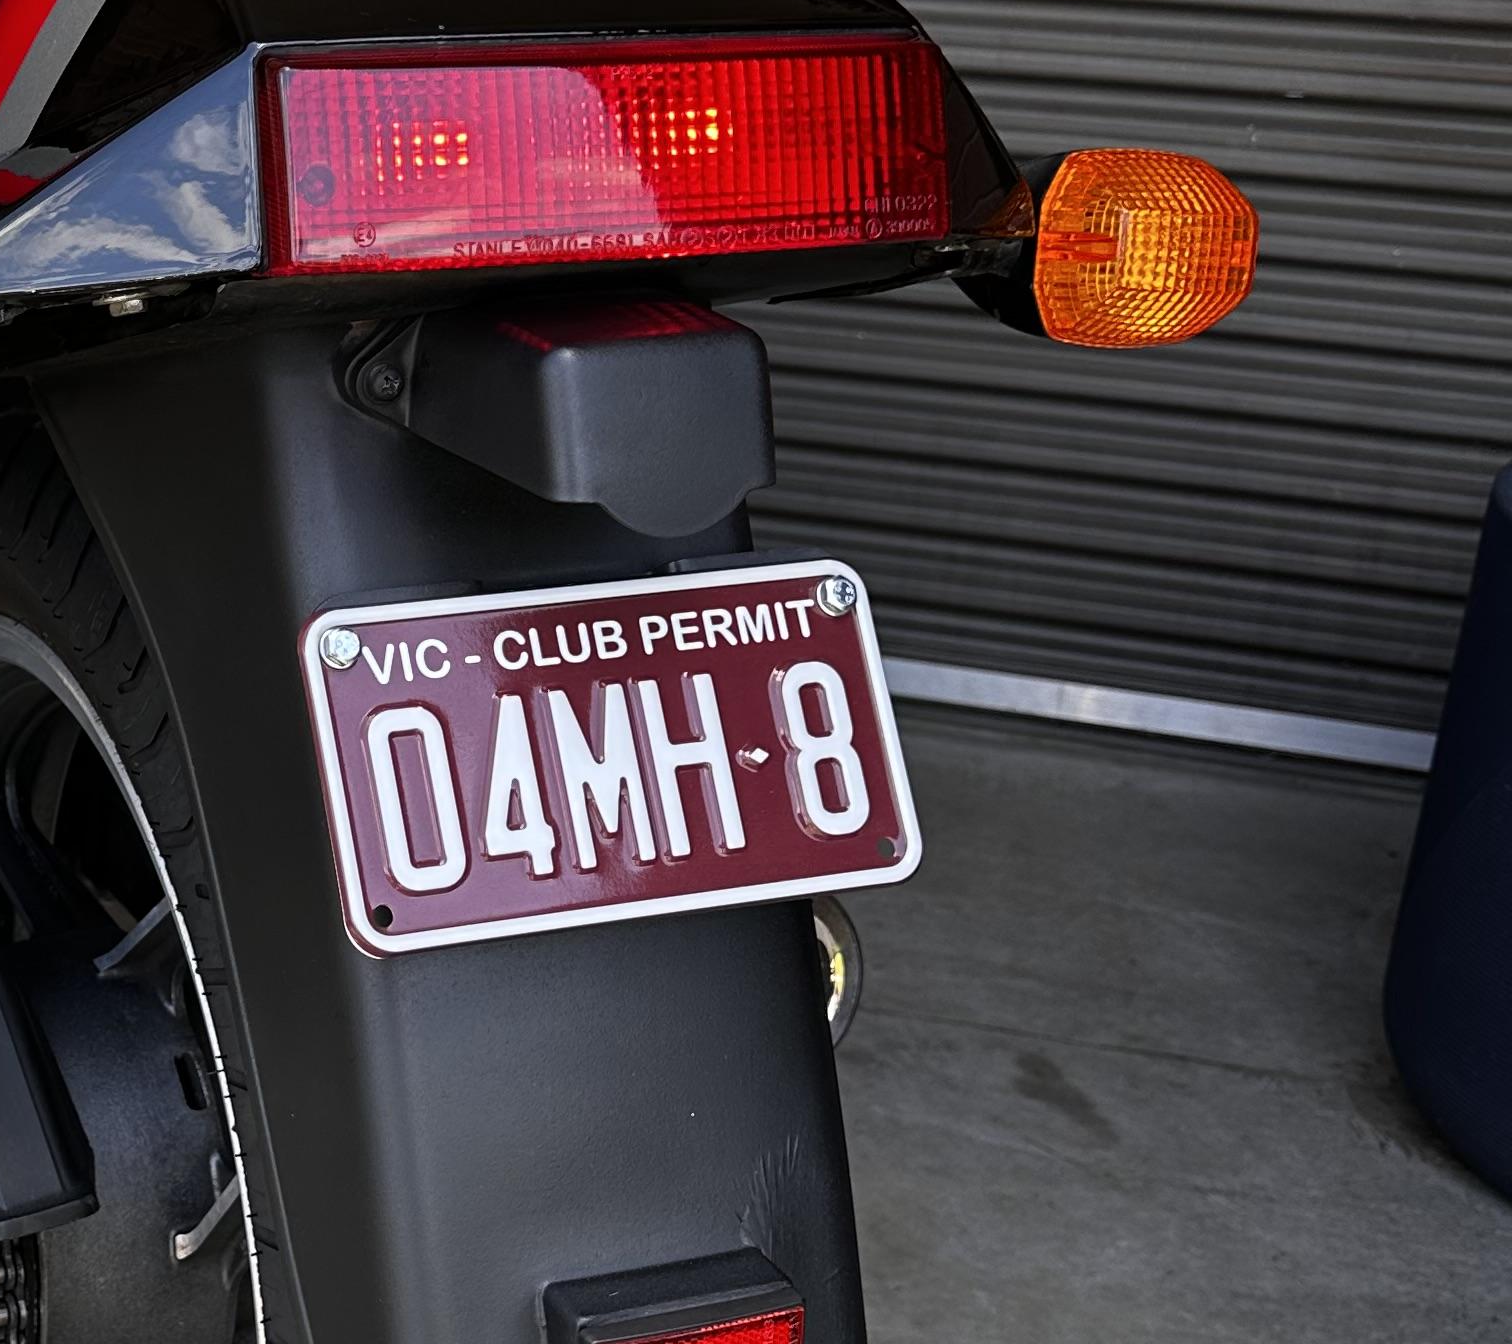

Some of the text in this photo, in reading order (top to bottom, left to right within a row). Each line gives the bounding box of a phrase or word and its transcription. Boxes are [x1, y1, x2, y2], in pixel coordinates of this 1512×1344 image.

[362, 638, 450, 685] VIC
[492, 621, 628, 670] CLUB
[639, 599, 816, 655] PERMIT
